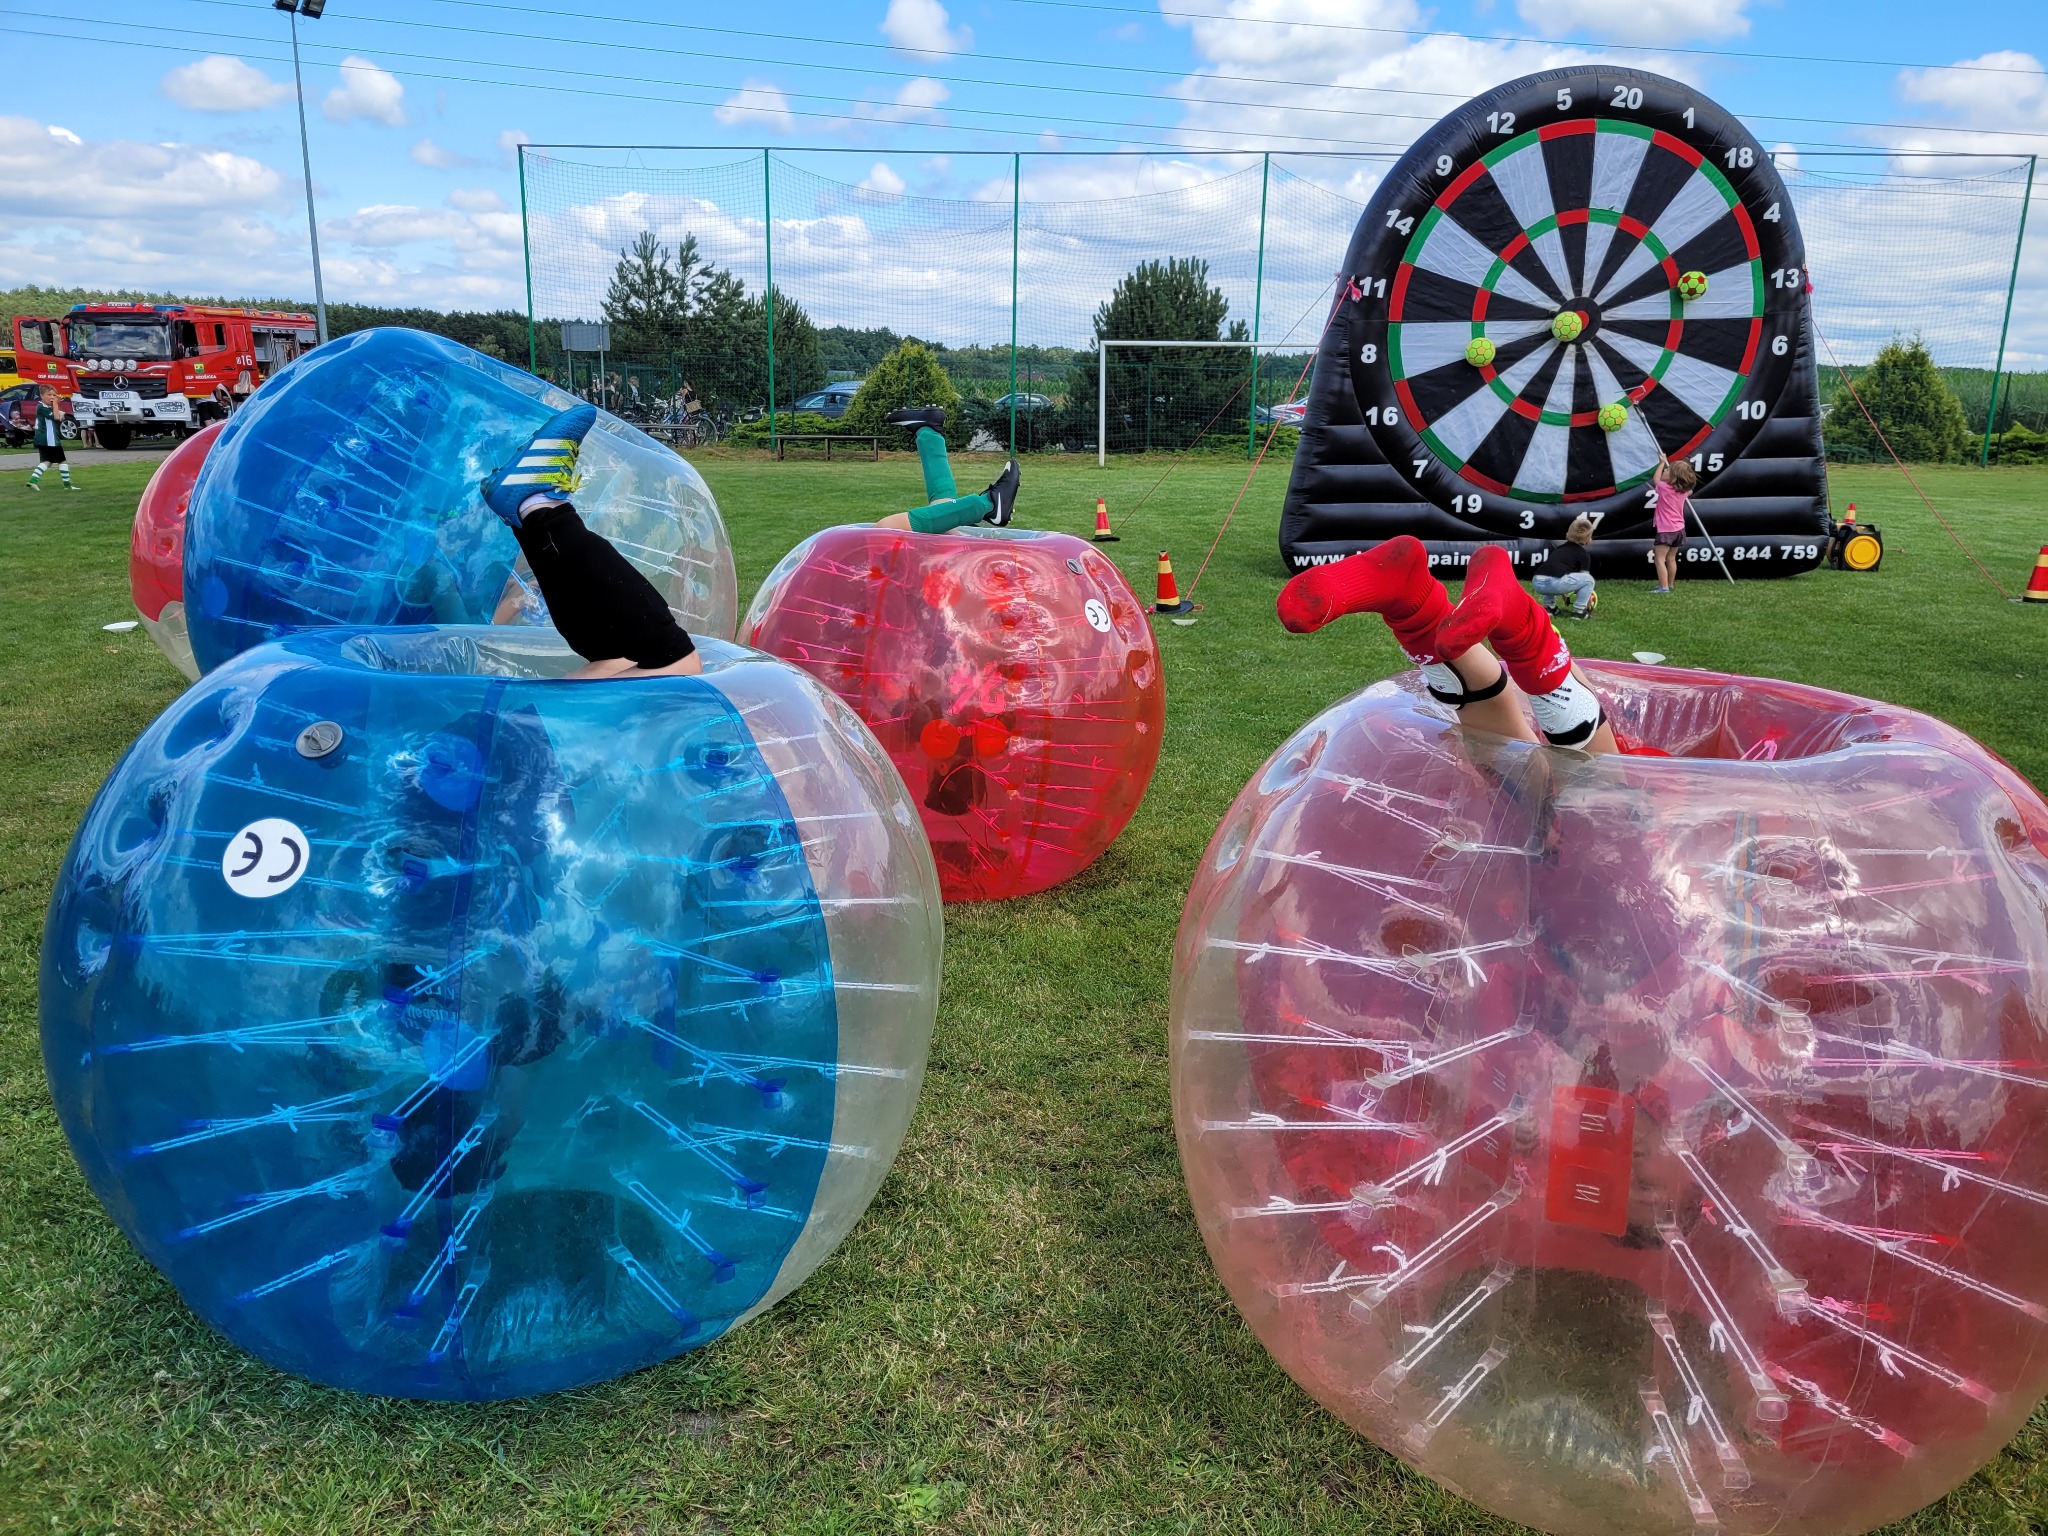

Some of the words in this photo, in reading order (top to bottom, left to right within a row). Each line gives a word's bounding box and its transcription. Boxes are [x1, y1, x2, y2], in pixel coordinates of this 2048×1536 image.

[1556, 88, 1572, 110] 5
[1610, 85, 1643, 109] 20
[1486, 111, 1516, 134] 12
[1682, 107, 1695, 129] 1
[1435, 154, 1452, 177] 9
[1724, 147, 1753, 168] 18
[1386, 208, 1415, 236] 14
[1763, 203, 1781, 222] 4
[1360, 276, 1387, 298] 11
[1771, 269, 1799, 289] 13
[1361, 343, 1377, 363] 8
[1771, 335, 1788, 355] 6
[1366, 406, 1398, 426] 16
[1736, 400, 1766, 420] 10
[1413, 459, 1428, 478] 7
[1690, 453, 1724, 472] 15
[1451, 494, 1482, 513] 19
[1644, 489, 1659, 509] 2
[1519, 510, 1535, 529] 3
[1686, 547, 1725, 562] 692
[1732, 545, 1772, 561] 844
[1780, 544, 1818, 560] 759
[230, 831, 302, 883] CE
